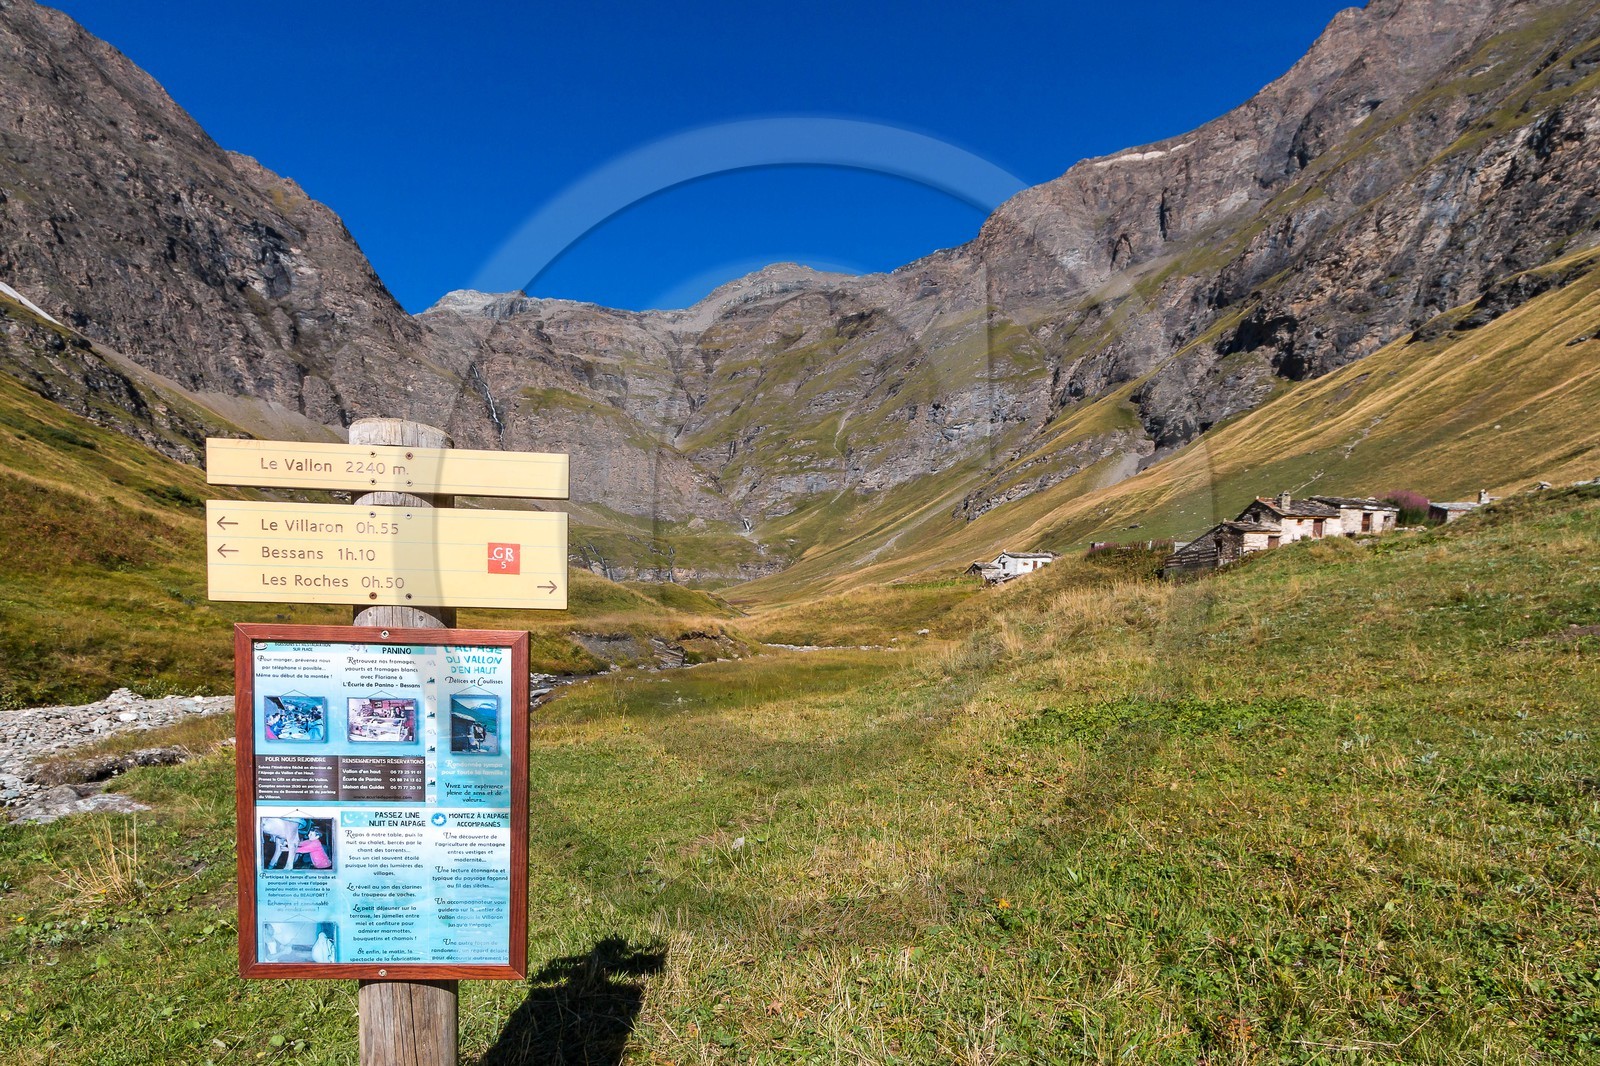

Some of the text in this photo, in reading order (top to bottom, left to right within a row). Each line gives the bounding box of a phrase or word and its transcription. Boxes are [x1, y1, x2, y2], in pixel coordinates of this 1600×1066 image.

[261, 457, 409, 476] Le Vallon 2240 m.
[261, 518, 399, 535] Le Villaron 0h.55
[261, 546, 376, 561] Bessans 1h.10
[493, 546, 514, 559] GR
[501, 561, 506, 569] 5
[262, 573, 405, 589] Les Roches 0h.50
[347, 657, 377, 665] Retrouvez
[464, 656, 502, 664] VALLON
[474, 666, 497, 674] HAUT
[445, 676, 468, 684] Délices
[477, 677, 503, 686] Coulisses
[345, 830, 364, 839] Repas
[347, 882, 355, 891] Le
[353, 904, 361, 912] Le
